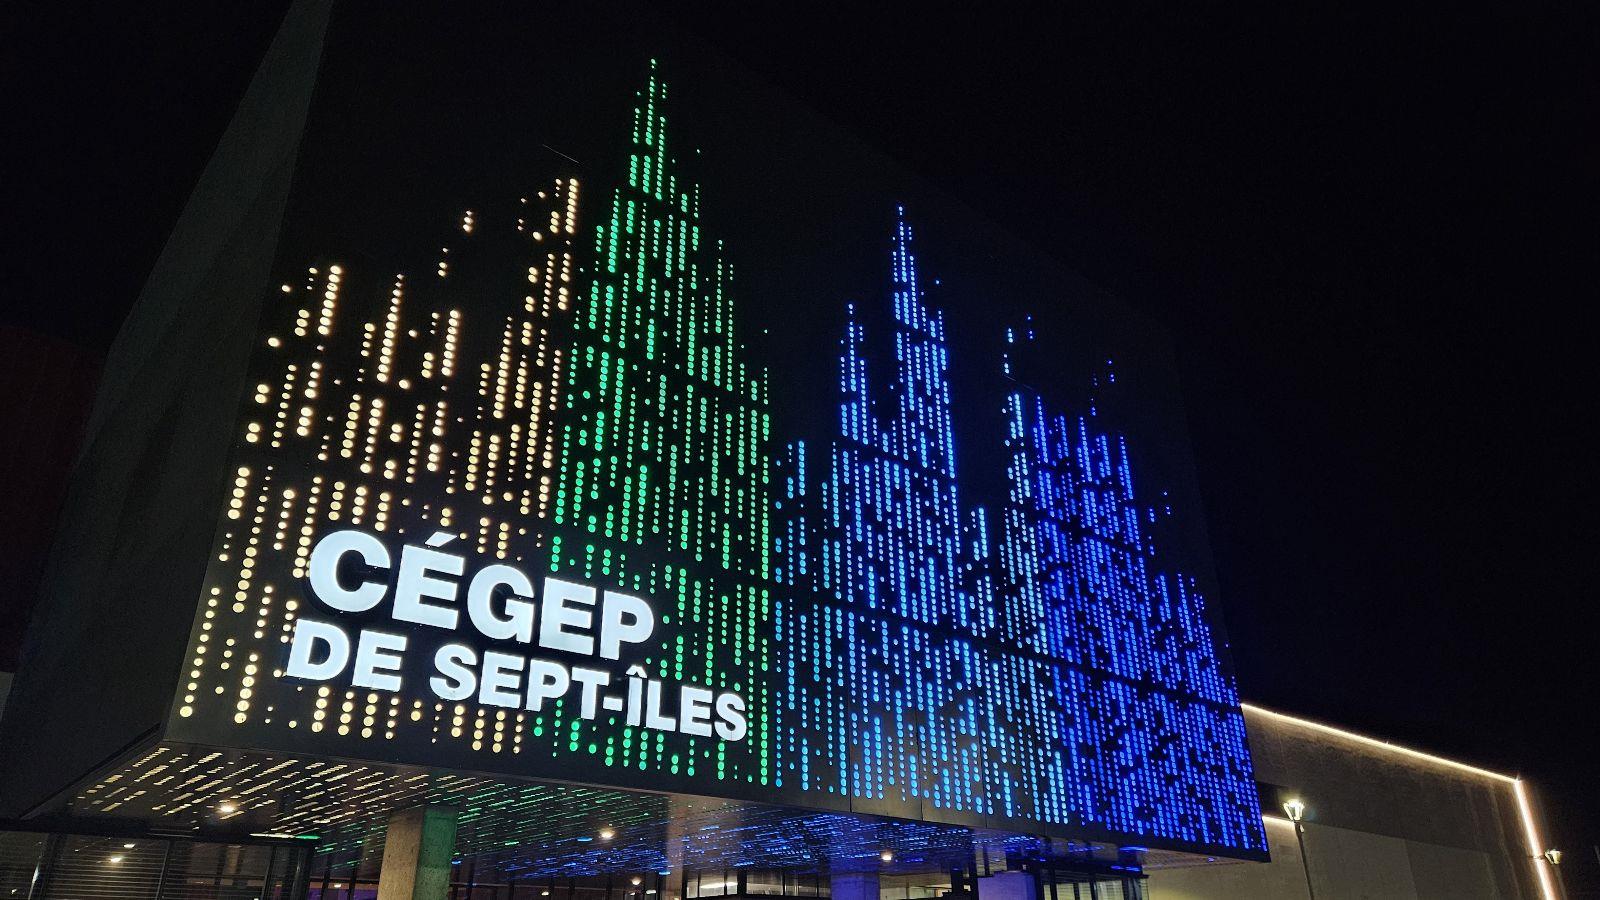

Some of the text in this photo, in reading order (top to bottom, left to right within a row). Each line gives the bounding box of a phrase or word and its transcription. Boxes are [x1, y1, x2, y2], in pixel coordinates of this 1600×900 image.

[308, 529, 655, 661] CÉGEP
[285, 618, 747, 742] DE SEPT-ÎLES
